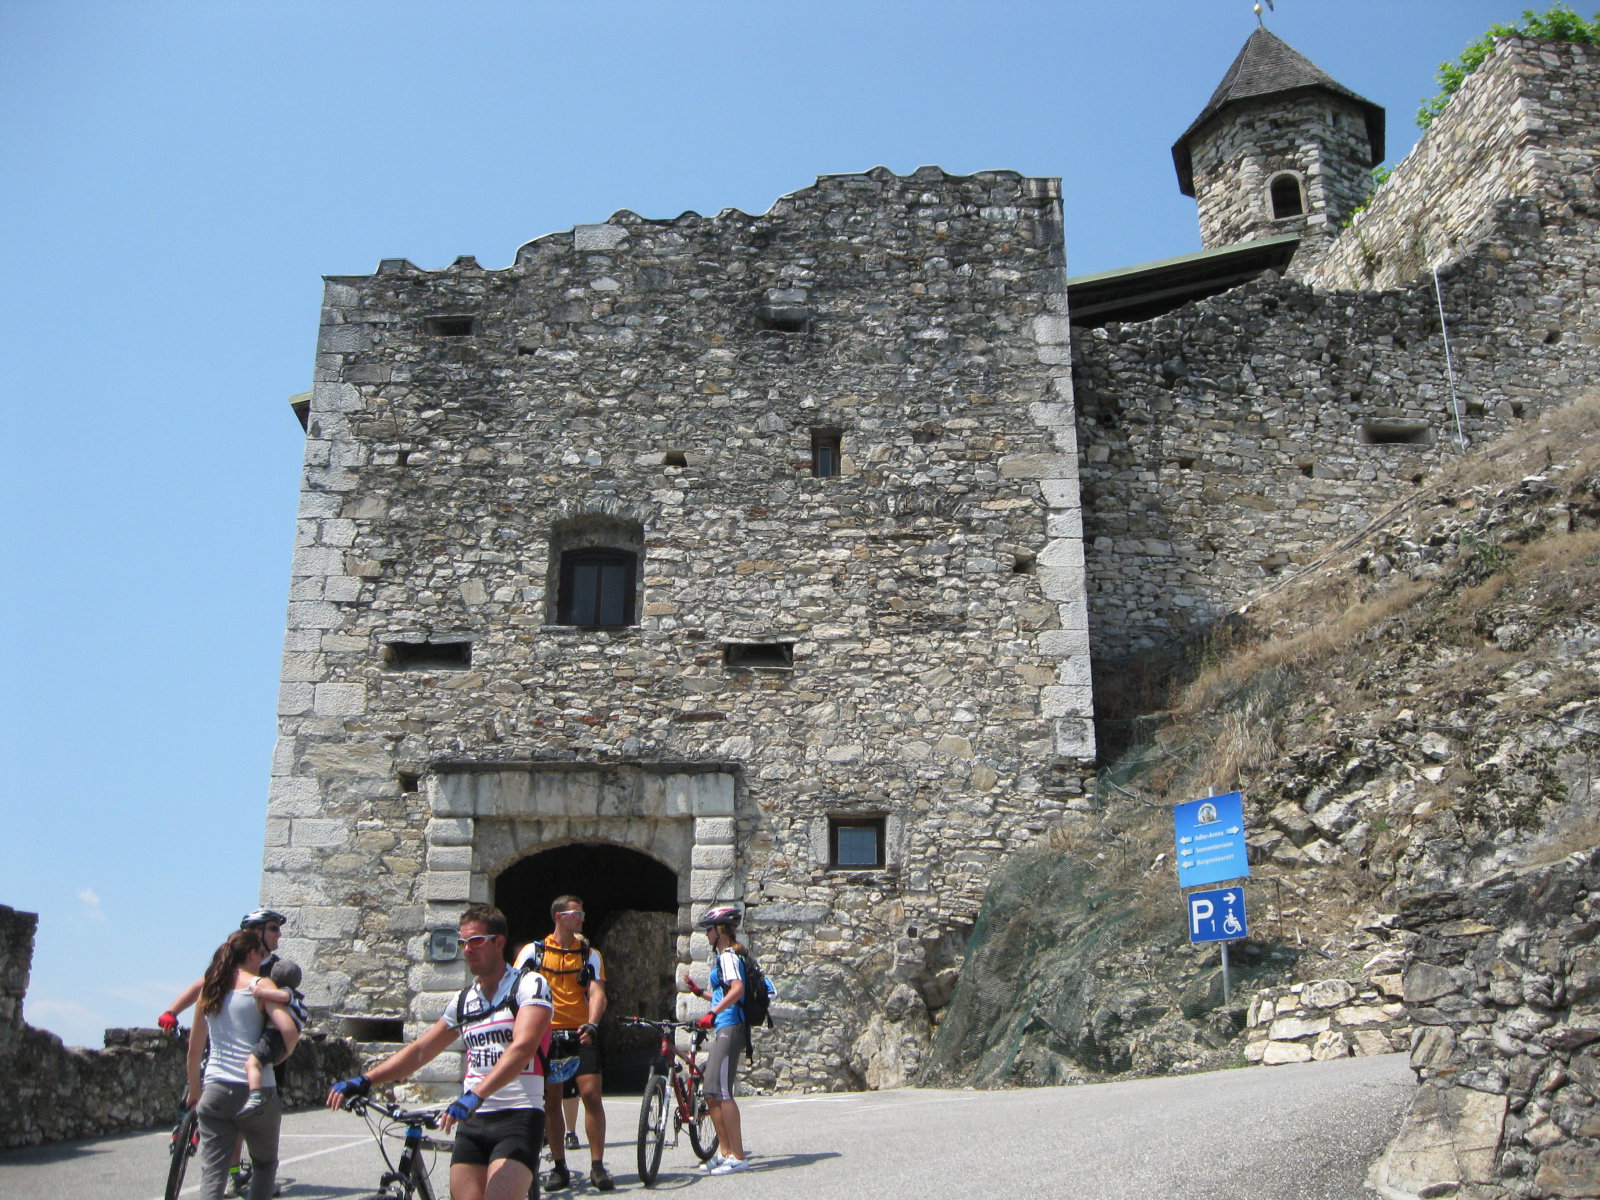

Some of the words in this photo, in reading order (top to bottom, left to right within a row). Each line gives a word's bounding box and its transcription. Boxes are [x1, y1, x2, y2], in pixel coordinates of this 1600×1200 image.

[1195, 831, 1224, 841] Adler-Arena
[1192, 899, 1214, 934] P
[1211, 919, 1216, 932] 1
